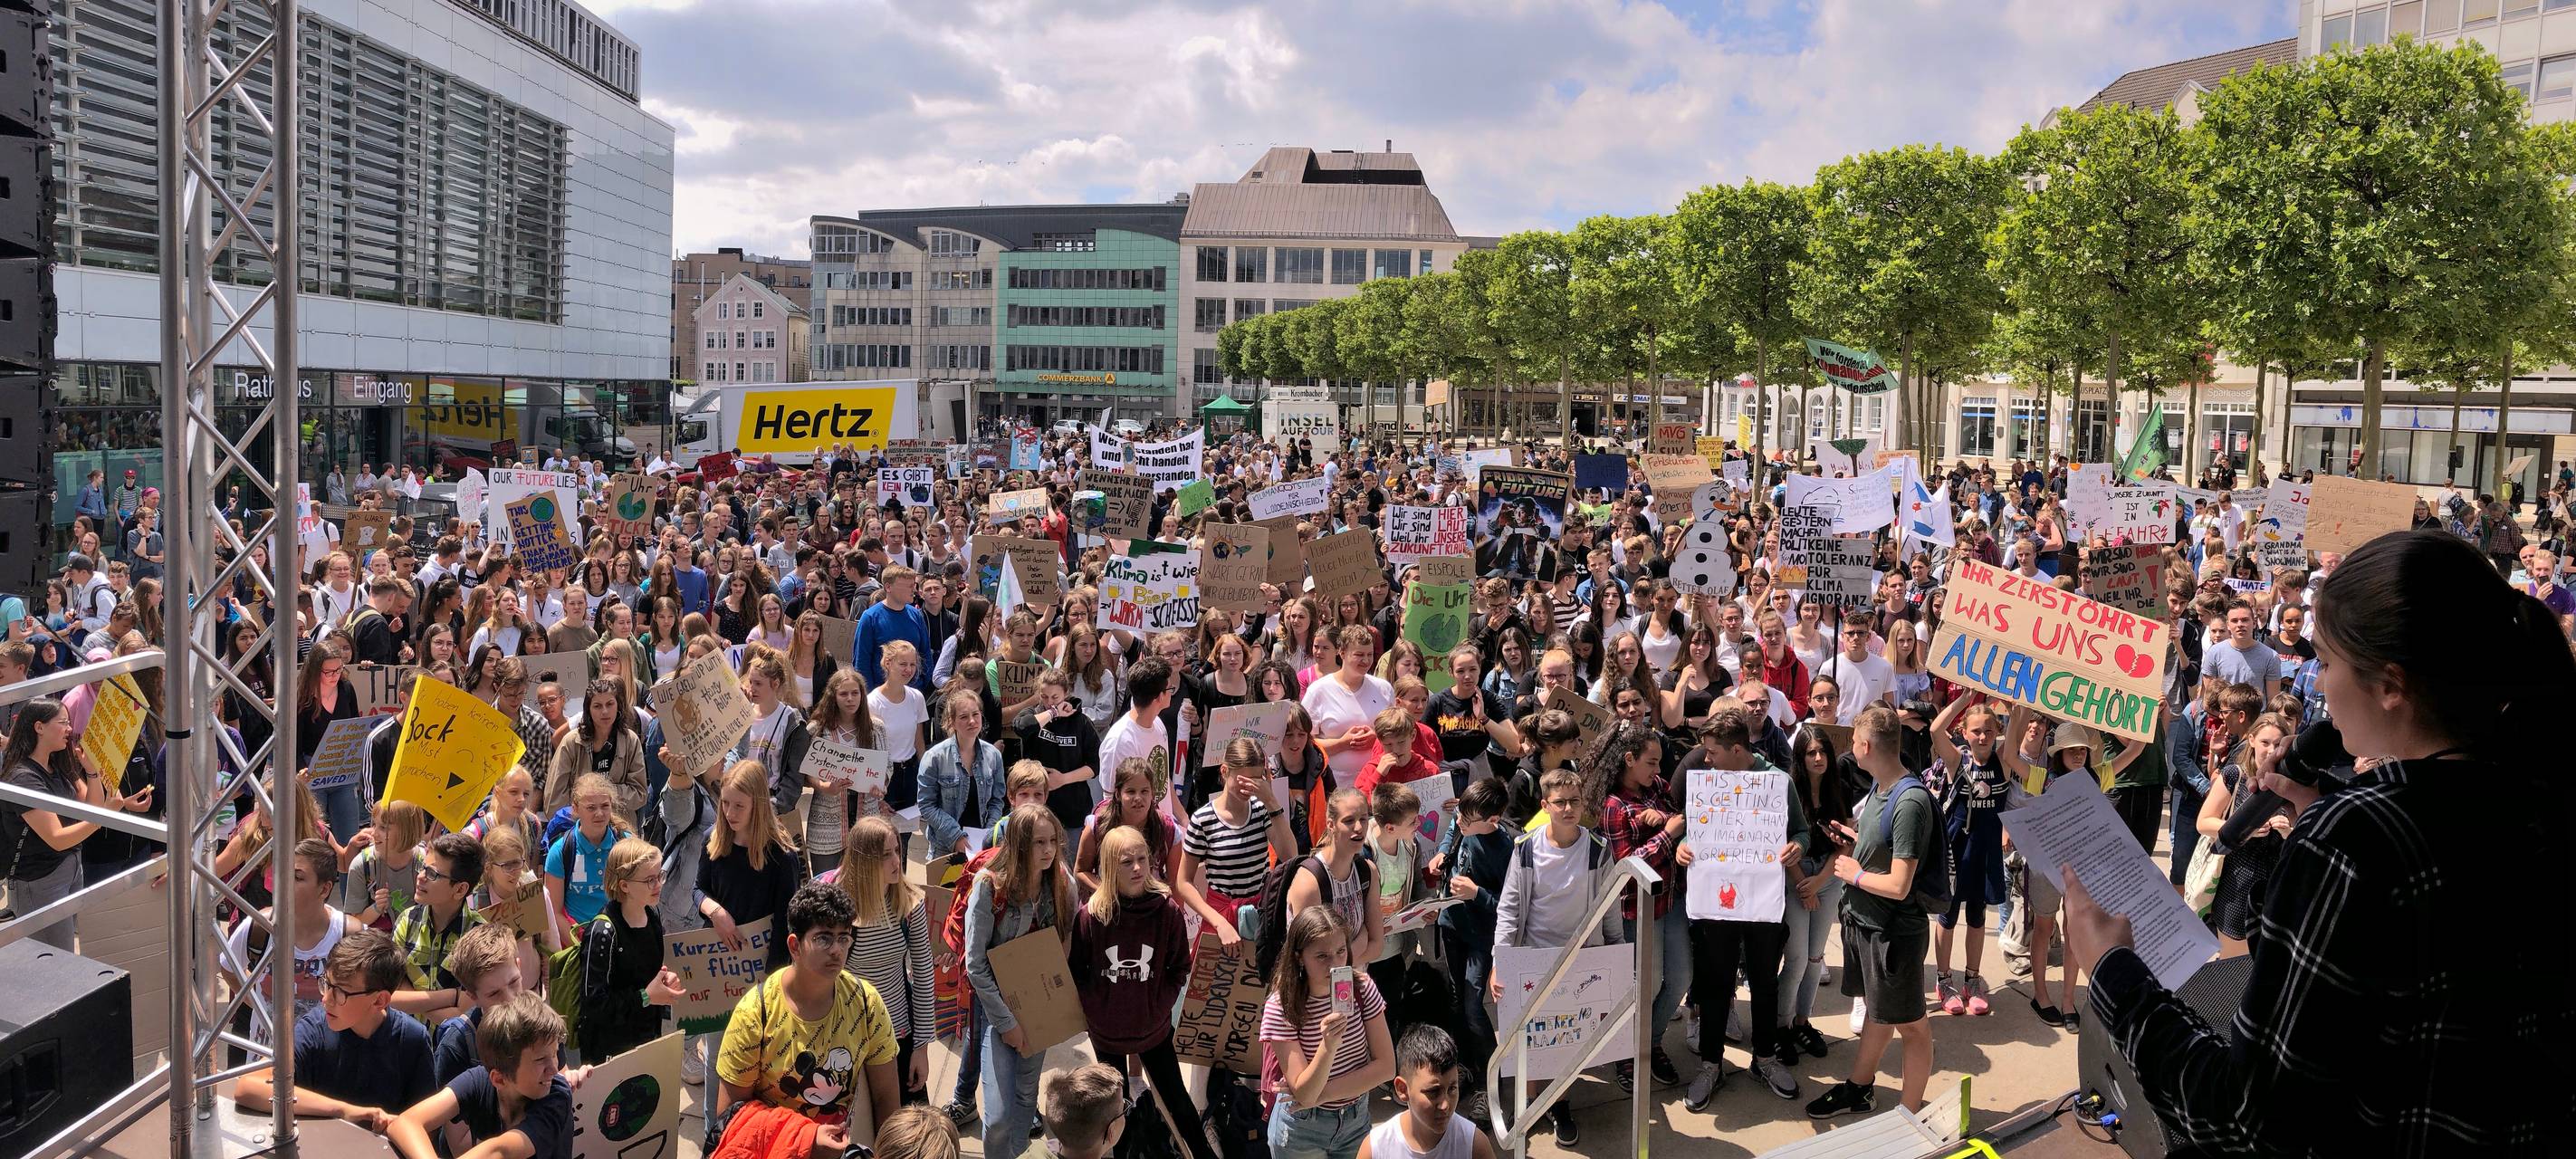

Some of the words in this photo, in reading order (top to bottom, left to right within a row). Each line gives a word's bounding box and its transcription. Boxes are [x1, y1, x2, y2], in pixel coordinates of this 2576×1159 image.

[1038, 374, 1101, 383] COMMERZBANK
[354, 376, 412, 404] Eingang
[1290, 389, 1323, 398] Krombacher
[2208, 388, 2251, 398] Sparkasse
[753, 403, 873, 440] Hertz
[1280, 413, 1334, 426] INSEL
[1306, 427, 1334, 436] TOUR
[1659, 427, 1686, 439] MVG
[1098, 432, 1118, 447] Wer
[1179, 441, 1195, 451] hat
[1102, 450, 1122, 463] und
[1152, 455, 1189, 467] handelt
[1646, 455, 1699, 469] Fehlstunden
[493, 472, 512, 484] OUR
[516, 473, 555, 487] FUTURE
[556, 473, 577, 489] LIES
[882, 470, 899, 481] ES
[904, 469, 929, 481] GIBT
[618, 475, 627, 484] Die
[631, 477, 652, 493] Uhr
[882, 482, 901, 492] KEIN
[1483, 481, 1498, 498] 4
[1499, 482, 1566, 499] FUTURE
[1288, 492, 1299, 500] FÜR
[2137, 490, 2165, 498] ZUKUNFT
[2291, 490, 2310, 504] Ja
[508, 505, 529, 517] THIS
[1392, 506, 1407, 519] Wir
[1413, 509, 1431, 521] sind
[1439, 507, 1463, 520] HIER
[1659, 502, 1680, 514] eher
[1782, 506, 1817, 517] LEUTE
[2126, 503, 2140, 511] IST
[365, 514, 383, 522] WARS
[512, 518, 522, 528] IS
[1782, 516, 1832, 528] GESTERN
[2124, 512, 2137, 522] IN
[515, 521, 557, 537] GETTING
[609, 519, 649, 536] TICKT
[1392, 519, 1408, 532] Wir
[1410, 520, 1431, 532] sind
[1438, 519, 1467, 532] LAUT
[496, 526, 508, 541] IN
[1391, 531, 1411, 543] Weil
[1415, 532, 1430, 544] ihr
[1434, 532, 1467, 544] UNSERE
[1781, 528, 1822, 539] MACHEN
[1390, 542, 1444, 555] ZUKUNFT
[1808, 539, 1843, 552] KEINE
[2265, 541, 2302, 550] GRANDMA
[1808, 551, 1872, 568] TOLERANZ
[2265, 555, 2307, 567] SNOWMAN?
[1027, 564, 1040, 573] their
[1104, 559, 1148, 585] Klima
[1151, 560, 1169, 582] ist
[1173, 561, 1198, 579] wie
[1428, 562, 1466, 577] EISPOLE
[1808, 566, 1831, 579] FÜR
[2092, 565, 2112, 577] WIR
[1672, 578, 1702, 595] RETTET
[1708, 586, 1729, 595] OLAF
[1806, 578, 1843, 591] KLIMA
[2226, 580, 2265, 589] CLIMATE
[1027, 588, 1046, 596] duh!
[1133, 586, 1173, 606] Bier
[1411, 586, 1435, 608] Die
[1444, 589, 1469, 609] Uhr
[2125, 588, 2142, 600] IHR
[1805, 592, 1867, 607] IGNORANZ
[1961, 560, 1993, 588] IHR
[1998, 574, 2160, 643] ZERSTÖHRT
[2137, 599, 2155, 609] DIE
[1109, 599, 1144, 630] WARM
[1955, 593, 2012, 633] WAS
[2032, 616, 2108, 666] UNS
[705, 653, 724, 673] WITH
[657, 687, 675, 704] WIE
[675, 677, 696, 695] GREW
[695, 663, 705, 679] UP
[1940, 634, 2044, 704] ALLEN
[2039, 671, 2160, 734] GEHÖRT
[433, 693, 459, 712] haben
[406, 706, 456, 744] Bock
[1245, 716, 1261, 728] WIR
[418, 740, 442, 760] Mist
[598, 759, 609, 770] THE
[809, 752, 838, 770] System
[841, 766, 857, 774] not
[866, 768, 879, 779] the
[311, 773, 356, 787] SAVED!!!
[1432, 775, 1447, 787] NO
[1693, 772, 1729, 789] THIS
[1691, 791, 1704, 808] IS
[1709, 790, 1783, 810] GETTING
[1688, 808, 1745, 826] HOTTER
[1752, 809, 1786, 828] THAN
[1688, 829, 1705, 841] MY
[1187, 945, 1219, 1001] RETTEN
[690, 988, 710, 1002] nur
[724, 981, 746, 998] für
[805, 1023, 825, 1050] eriously
[1176, 1009, 1204, 1057] HEUTE
[1222, 1001, 1260, 1063] MORGEN
[1527, 1028, 1582, 1049] PLANET
[1196, 1030, 1219, 1060] WIR
